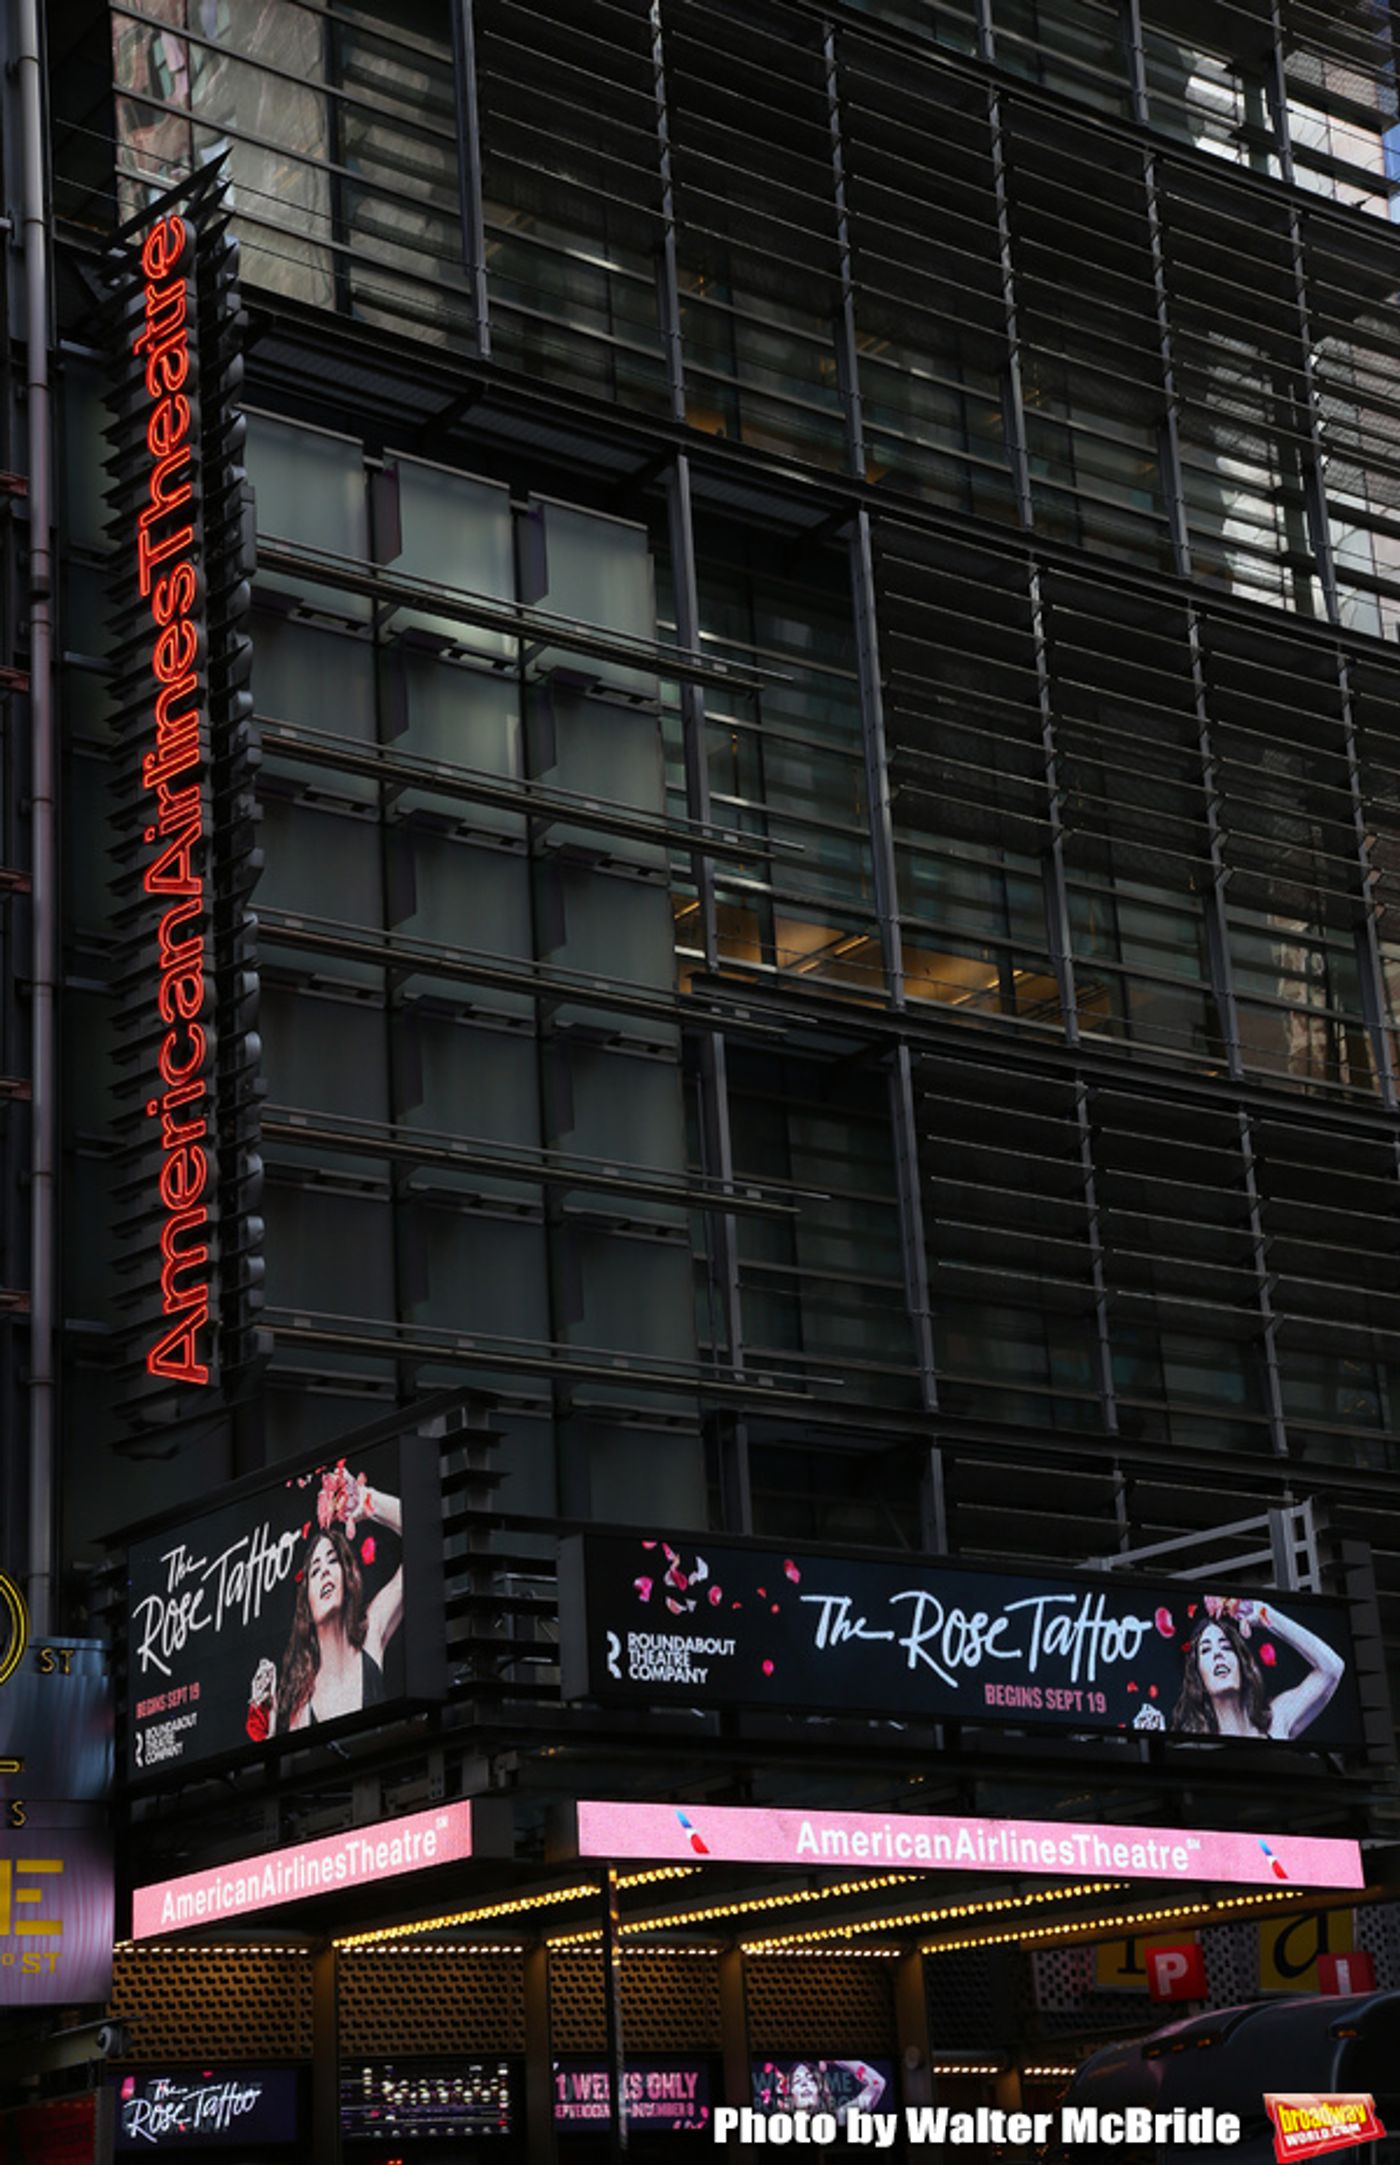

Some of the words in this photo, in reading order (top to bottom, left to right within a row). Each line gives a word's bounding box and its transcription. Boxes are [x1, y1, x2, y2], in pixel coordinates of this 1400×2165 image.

[134, 214, 209, 1386] AmericanAirlinesTheatre
[161, 1544, 207, 1593] The
[132, 1589, 212, 1676] Rose
[201, 1521, 302, 1632] Tattoo
[627, 1632, 736, 1656] ROUNDABOUT
[800, 1596, 894, 1649] The
[889, 1591, 1022, 1688] Rose
[1004, 1593, 1153, 1682] Tattoo
[628, 1650, 690, 1667] THEATRE
[628, 1664, 708, 1684] COMPANY
[136, 1694, 165, 1719] BEGINS
[168, 1686, 187, 1709] SEPT
[985, 1684, 1042, 1710] BEGINS
[1045, 1689, 1082, 1712] SEPT
[1086, 1692, 1107, 1713] 19
[145, 1712, 197, 1742] ROUNDABOUT
[145, 1741, 183, 1765] COMPANY
[1155, 1953, 1188, 1996] P
[149, 2078, 188, 2100] The
[647, 2073, 698, 2100] ONLY
[124, 2099, 192, 2143] Rose
[183, 2082, 262, 2128] Tattoo
